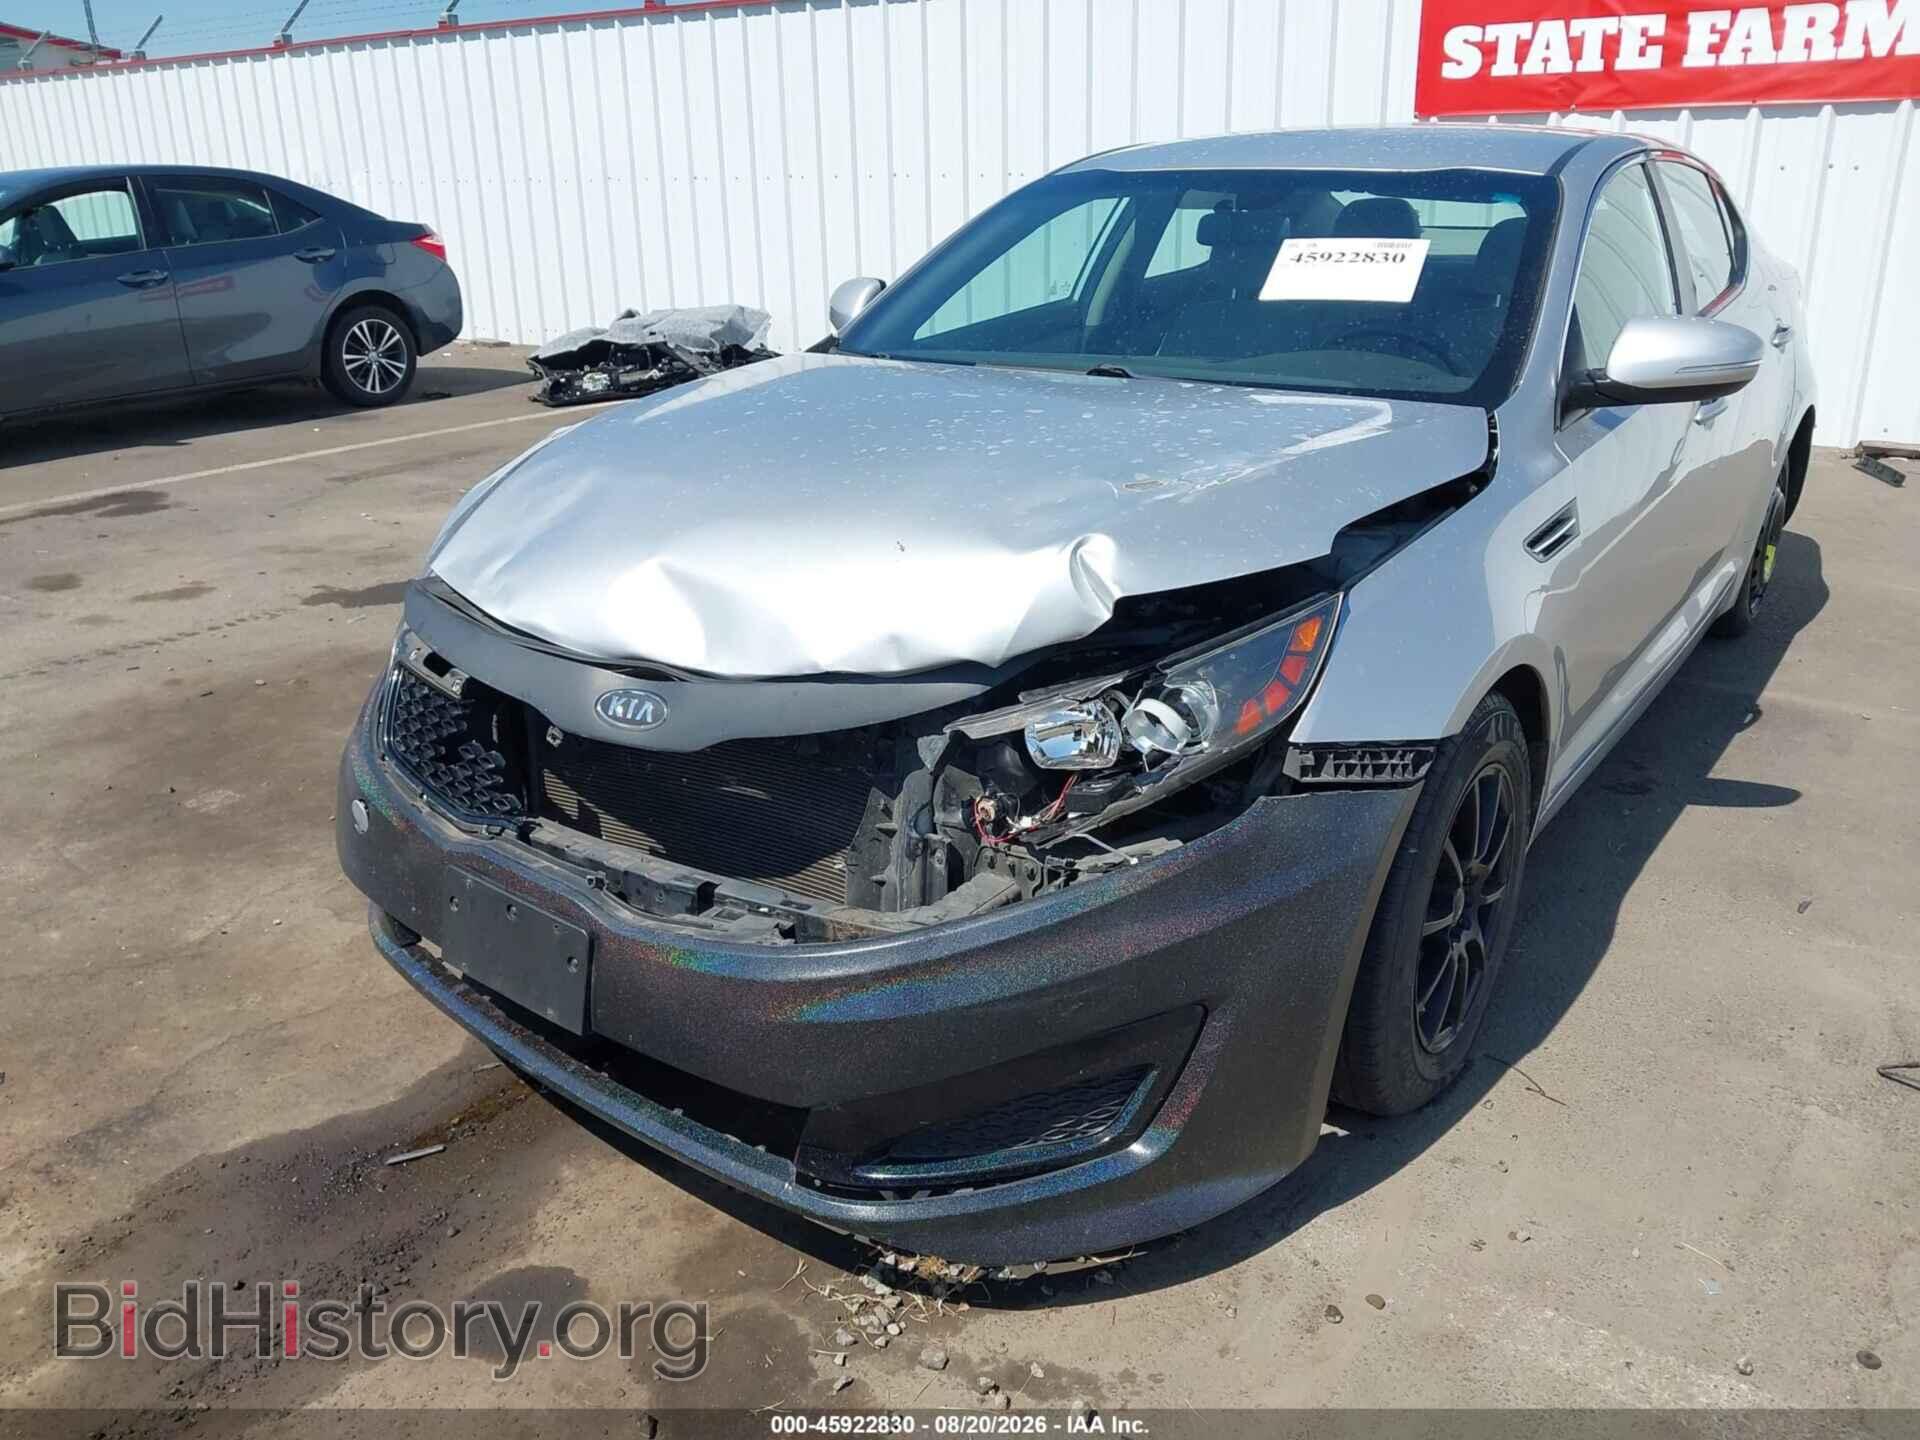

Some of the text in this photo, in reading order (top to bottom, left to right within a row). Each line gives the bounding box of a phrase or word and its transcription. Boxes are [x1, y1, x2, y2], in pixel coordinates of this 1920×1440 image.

[1441, 0, 1920, 79] STATE FARM
[1289, 251, 1406, 264] 45922830
[607, 695, 653, 722] KIA
